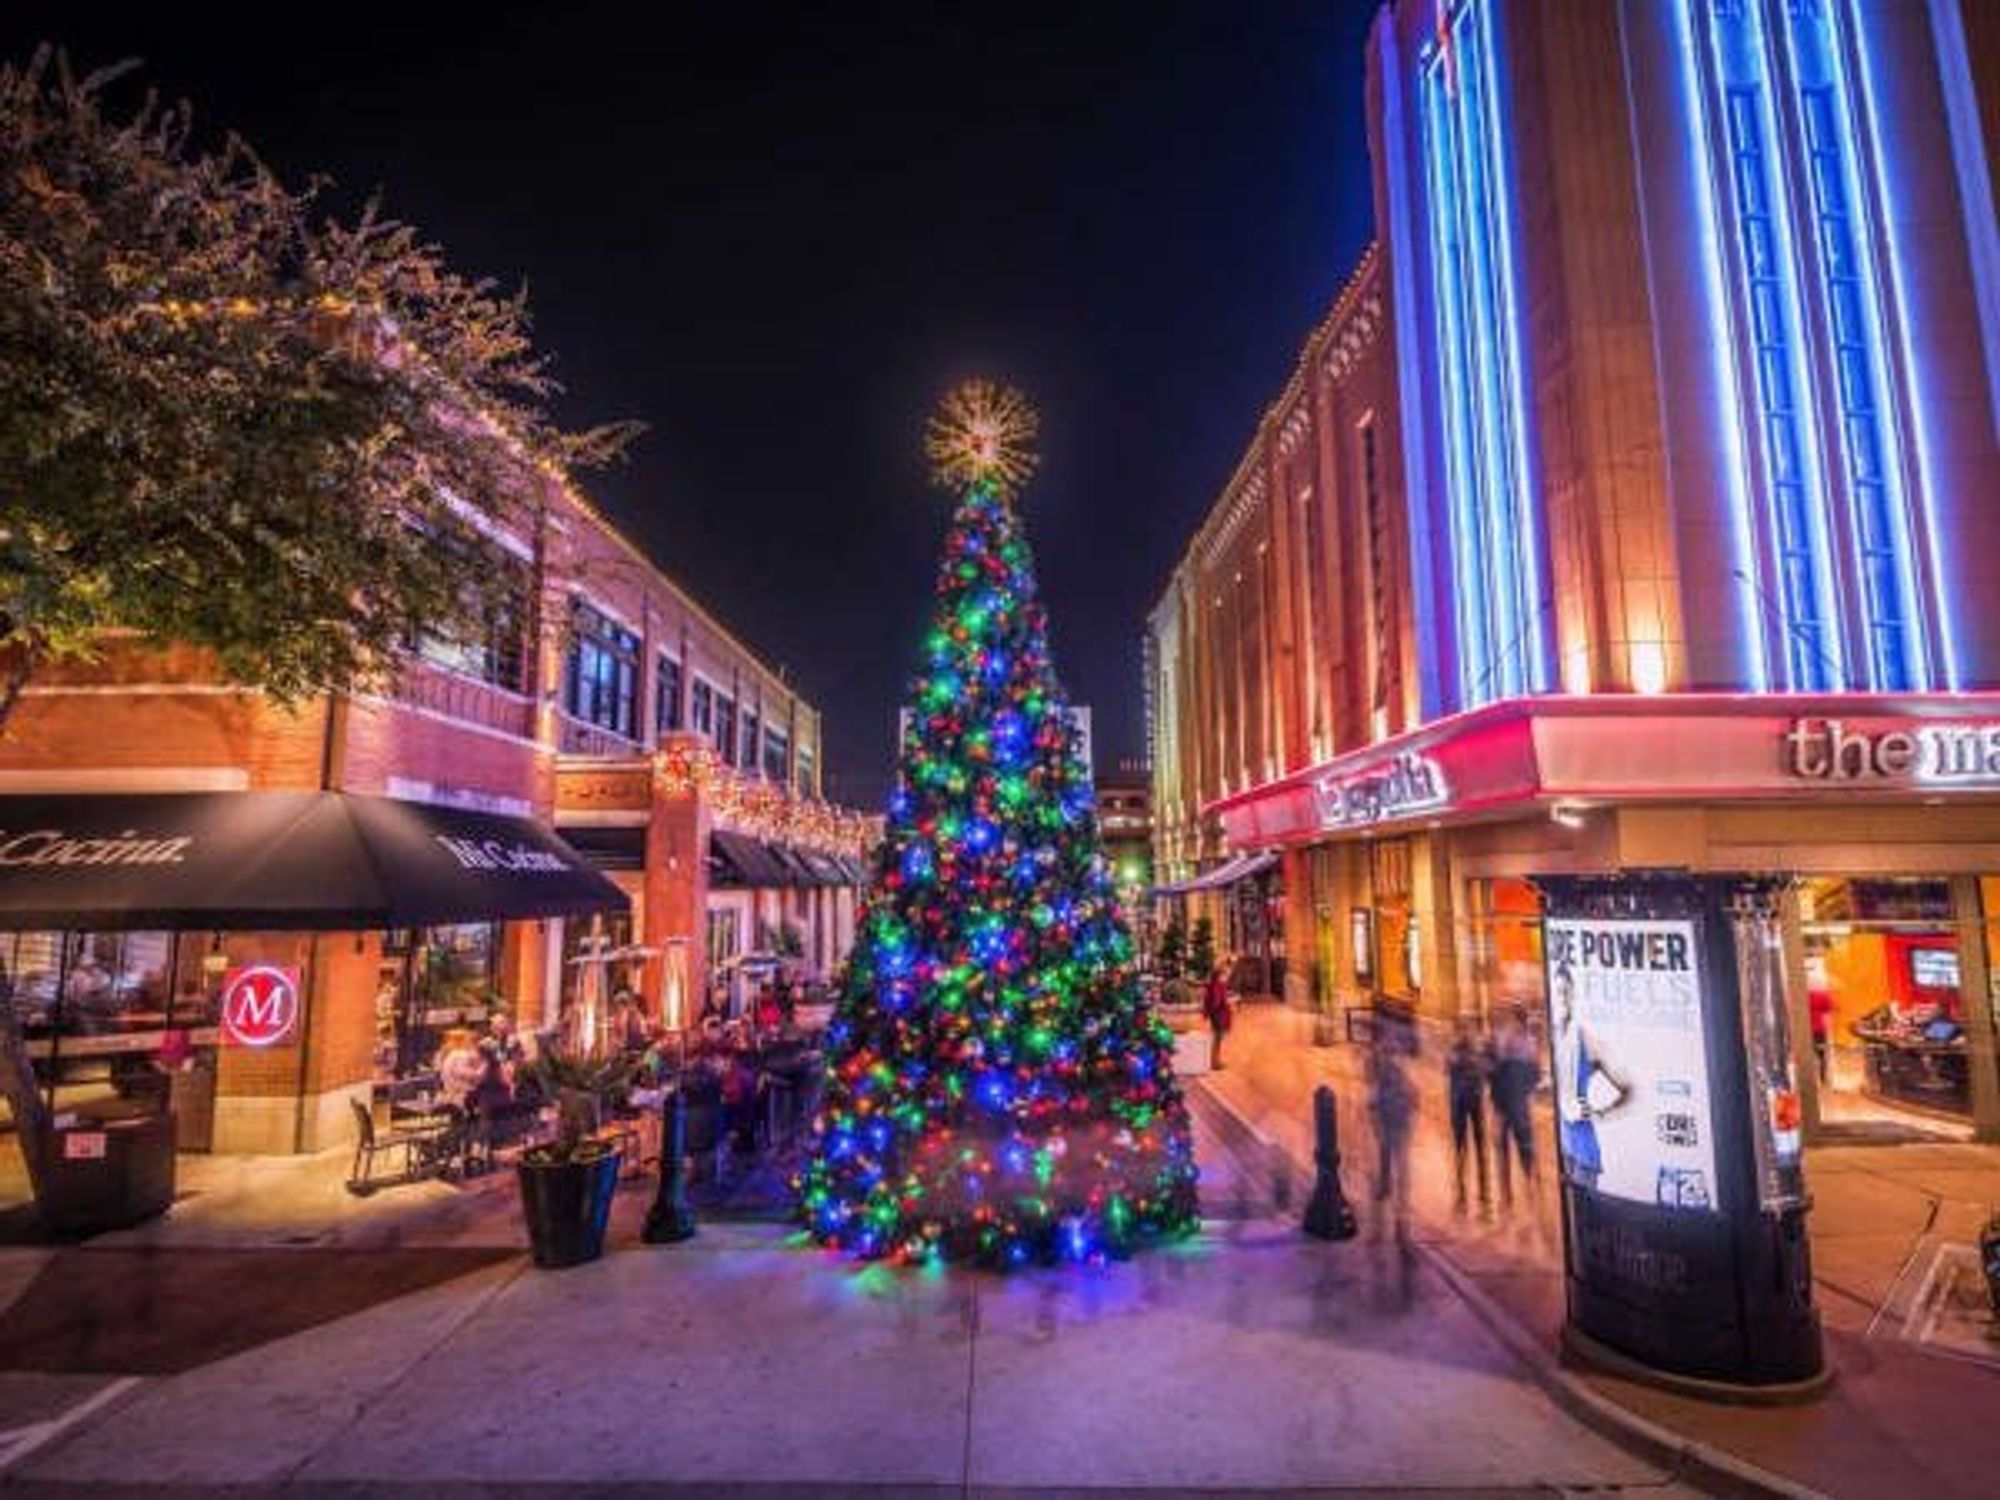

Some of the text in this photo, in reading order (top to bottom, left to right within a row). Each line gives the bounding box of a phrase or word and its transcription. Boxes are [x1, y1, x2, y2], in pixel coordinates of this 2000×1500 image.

[1786, 718, 1915, 778] the
[1580, 929, 1690, 972] POWER
[235, 986, 284, 1025] M
